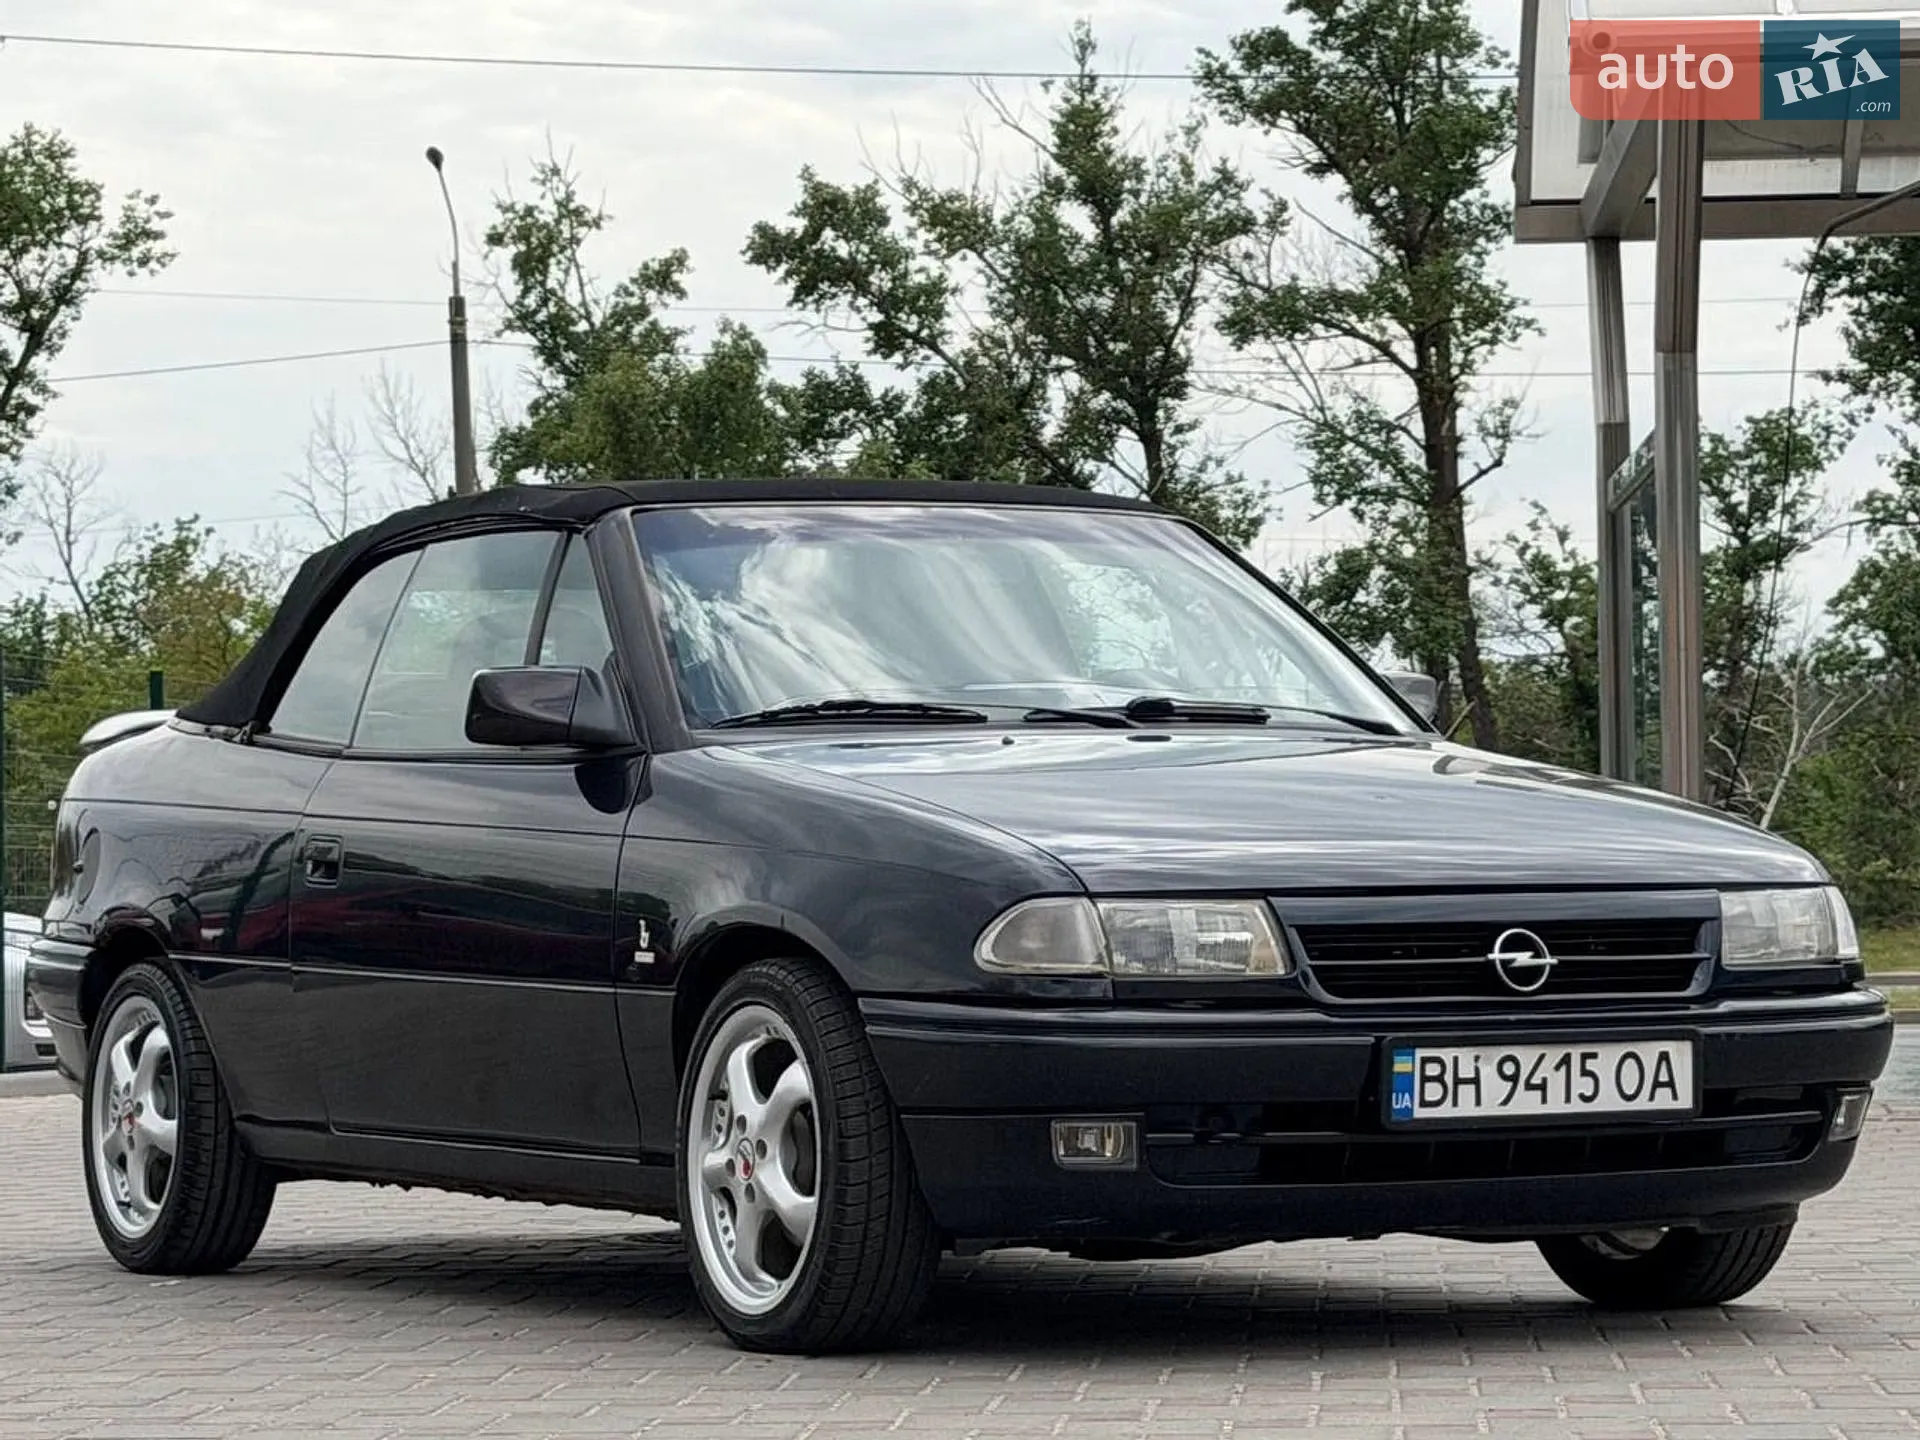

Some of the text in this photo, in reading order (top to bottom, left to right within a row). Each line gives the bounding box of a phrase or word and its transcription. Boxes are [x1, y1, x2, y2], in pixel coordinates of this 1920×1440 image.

[1418, 1050, 1679, 1108] BH 9415 OA
[1392, 1092, 1412, 1109] UA
